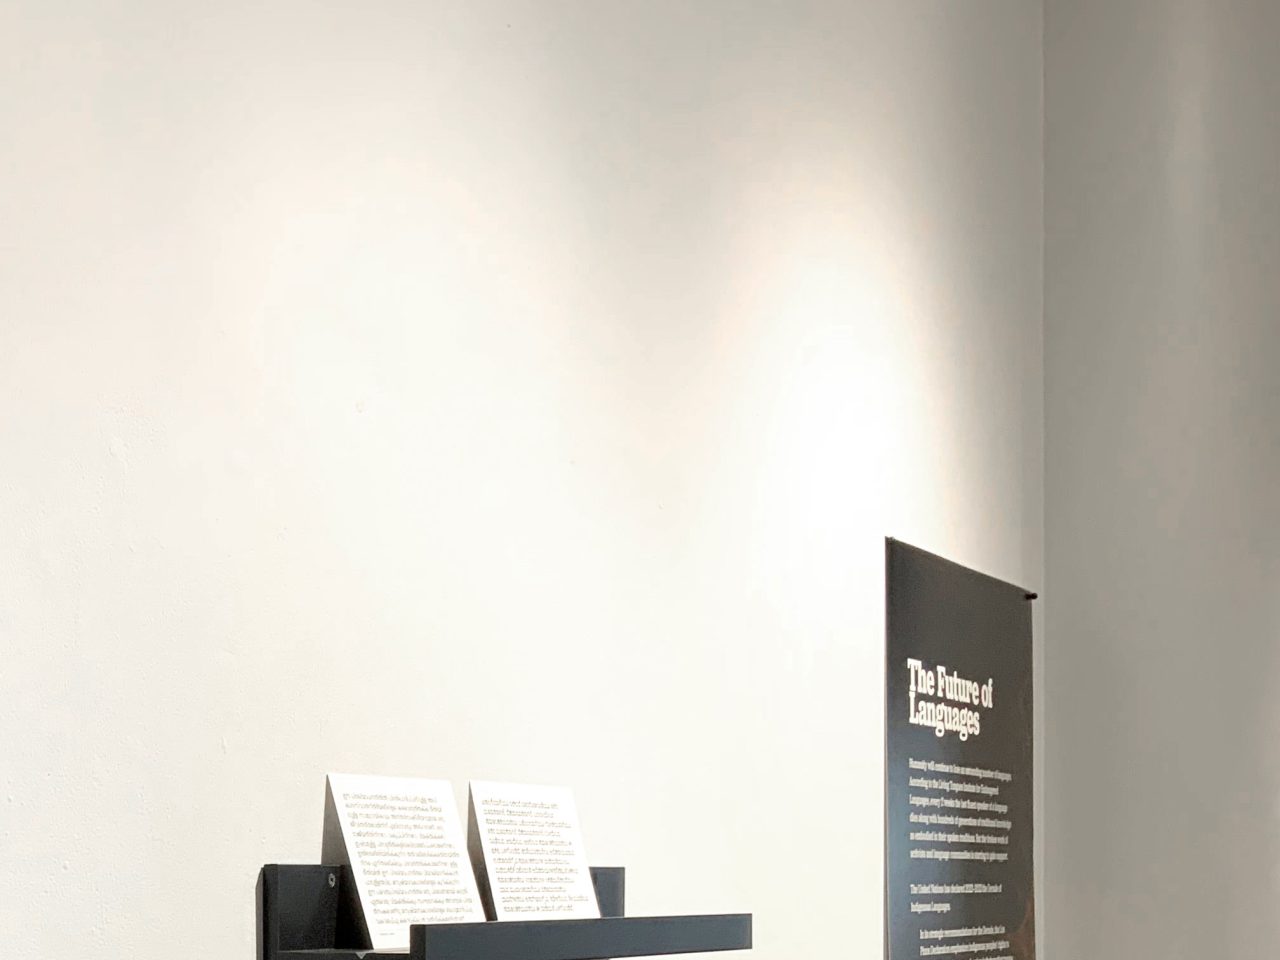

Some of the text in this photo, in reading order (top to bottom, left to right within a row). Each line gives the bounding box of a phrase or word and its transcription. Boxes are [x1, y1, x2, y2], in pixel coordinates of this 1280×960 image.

[907, 657, 993, 708] The Future of
[908, 691, 980, 741] Languages
